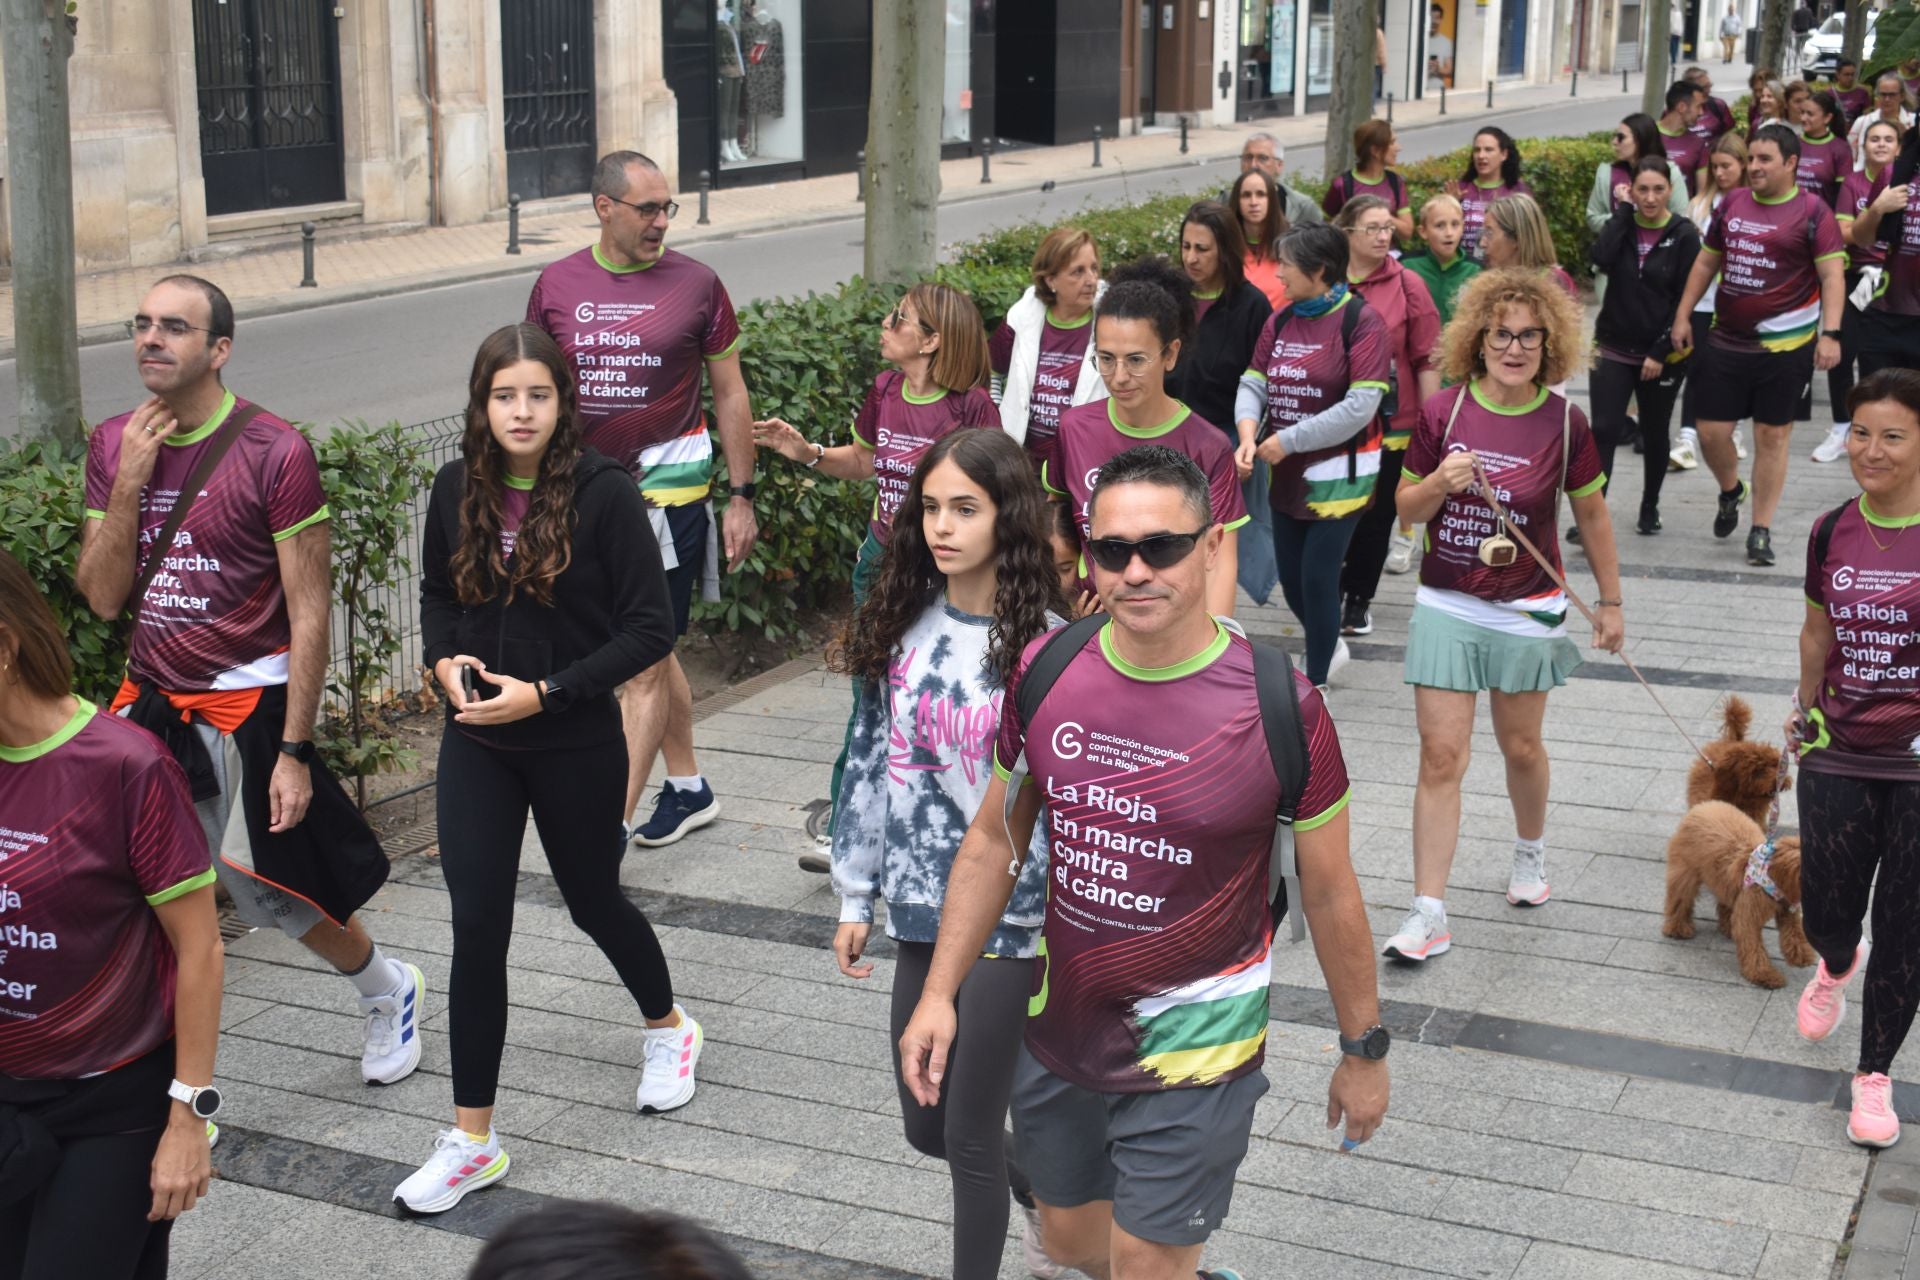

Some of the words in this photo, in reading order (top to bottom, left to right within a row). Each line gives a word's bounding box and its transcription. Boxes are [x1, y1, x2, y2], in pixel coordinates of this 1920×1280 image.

[1738, 240, 1765, 254] Rioja
[1736, 255, 1776, 269] marcha
[1731, 274, 1765, 288] cáncer
[575, 332, 594, 346] La
[600, 332, 640, 348] Rioja
[576, 353, 595, 366] En
[601, 353, 662, 366] marcha
[580, 368, 626, 381] contra
[1279, 366, 1307, 380] Rioja
[580, 382, 590, 396] el
[593, 383, 649, 397] cáncer
[1039, 374, 1069, 390] Rioja
[1280, 385, 1322, 398] marcha
[1442, 514, 1491, 534] contra
[1439, 528, 1452, 543] el
[1875, 584, 1892, 592] Rioja
[1830, 603, 1852, 619] La
[1857, 603, 1908, 624] Rioja
[1836, 626, 1856, 642] En
[1861, 630, 1920, 646] march
[1842, 646, 1891, 664] contra
[1843, 661, 1856, 678] el
[1859, 664, 1920, 681] cáncer
[1089, 742, 1120, 756] contra
[1122, 750, 1130, 759] el
[1133, 752, 1167, 768] cáncer
[1091, 732, 1141, 750] asociación
[1143, 744, 1190, 763] española
[1087, 754, 1099, 763] en
[1101, 754, 1113, 766] La
[1115, 758, 1139, 773] Rioja
[1047, 776, 1079, 804] La
[1087, 784, 1157, 823] Rioja
[13, 832, 48, 844] española
[1053, 809, 1078, 839] En
[1085, 825, 1193, 865] marcha
[4, 841, 30, 852] cáncer
[1055, 840, 1128, 881] contra
[1055, 865, 1068, 889] el
[1072, 877, 1166, 913] cáncer
[1075, 909, 1101, 922] ESPAÑOLA
[1101, 918, 1126, 929] CONTRA
[1137, 924, 1163, 932] CÁNCER
